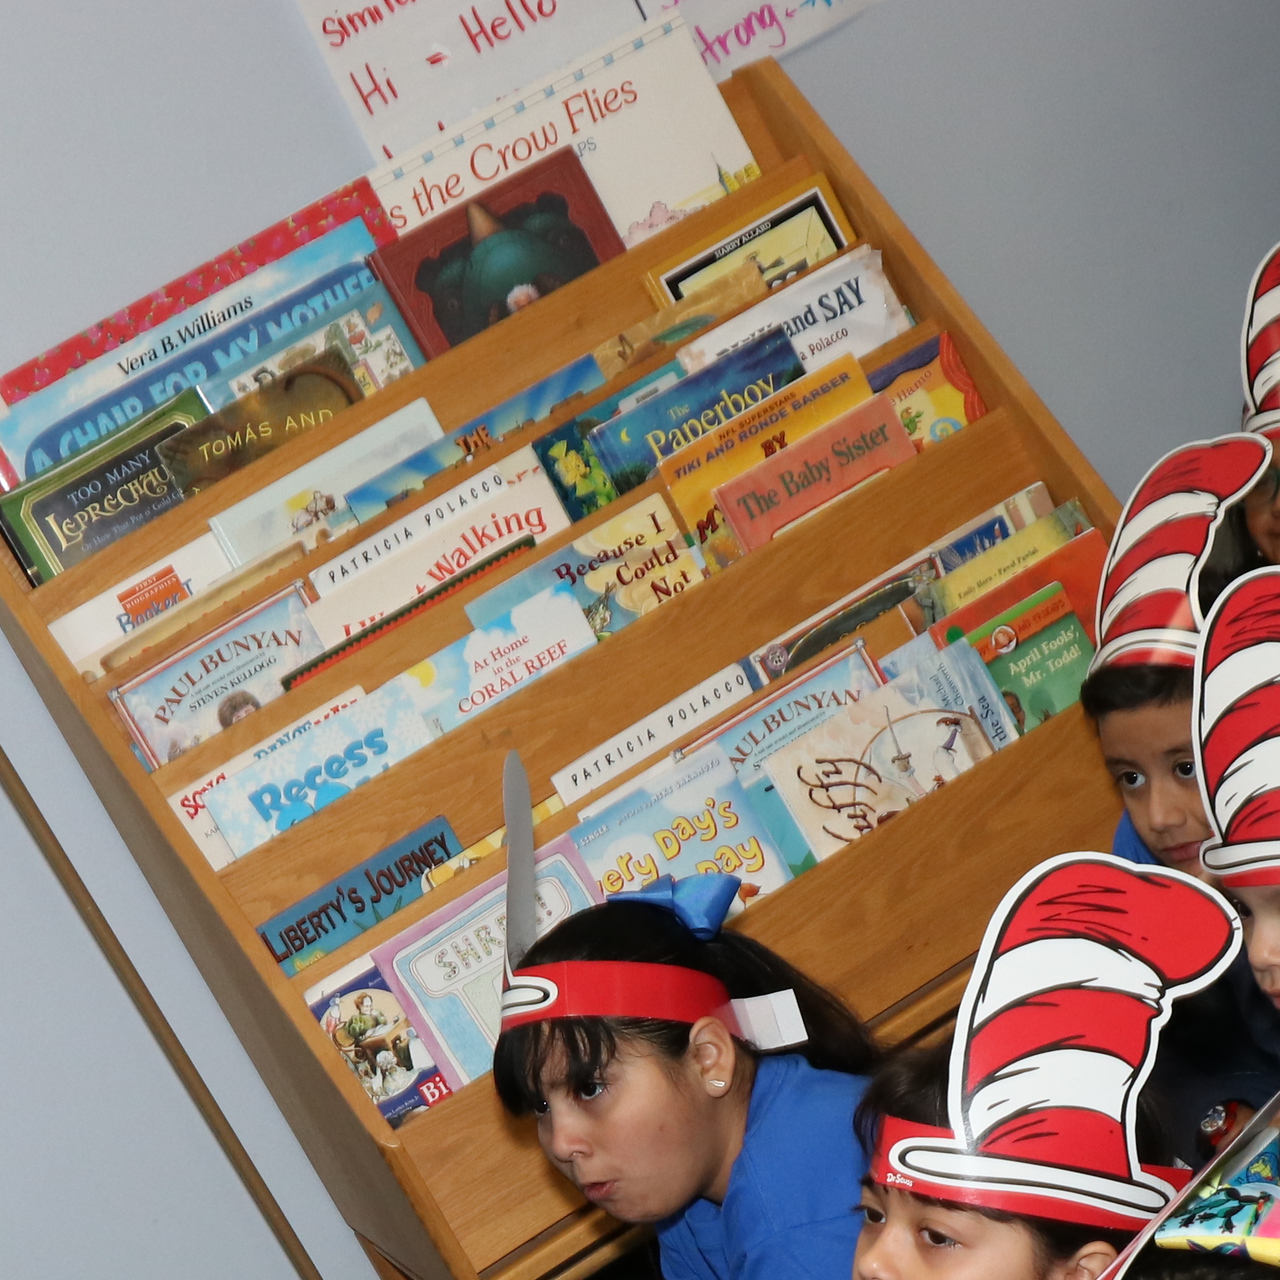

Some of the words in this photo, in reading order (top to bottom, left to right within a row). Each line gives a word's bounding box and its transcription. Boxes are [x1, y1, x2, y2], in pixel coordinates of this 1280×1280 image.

[693, 3, 787, 65] trong
[349, 62, 398, 116] Hi
[390, 205, 408, 229] s
[412, 173, 465, 217] the
[470, 121, 558, 181] Crow
[562, 80, 638, 134] Flies
[577, 137, 598, 158] PS
[715, 236, 741, 259] HARRY
[741, 221, 771, 245] ALLARD
[782, 303, 820, 338] and
[818, 275, 867, 323] SAY
[117, 348, 158, 376] Vera
[160, 335, 179, 354] B.
[177, 296, 254, 344] Williams
[808, 327, 849, 357] Polacco
[199, 420, 273, 462] TOMÁS
[285, 408, 334, 433] AND
[644, 372, 776, 461] Paperboy
[667, 402, 691, 421] The
[674, 458, 702, 480] TIKI
[705, 438, 735, 460] AND
[738, 407, 789, 443] RONDE
[792, 371, 852, 412] BARBER
[718, 426, 738, 440] NFL
[738, 391, 797, 429] SUPERSTARS
[760, 430, 789, 458] BY
[67, 480, 102, 507] TOO
[105, 449, 152, 485] MANY
[736, 487, 781, 522] The
[778, 455, 833, 500] Baby
[830, 422, 891, 468] Sister
[45, 464, 170, 552] LEPRECHAU
[328, 526, 414, 583] PATRICIA
[424, 473, 503, 526] POLACCO
[426, 506, 548, 583] Walking
[553, 532, 647, 587] Because
[647, 511, 666, 536] I
[615, 539, 681, 587] Could
[125, 577, 177, 609] BIOGRAPHIES
[134, 575, 157, 592] FIRST
[649, 568, 692, 604] Not
[116, 592, 181, 634] Booker
[154, 667, 204, 725] PAUL
[199, 628, 304, 675] BUNYAN
[458, 668, 525, 715] CORAL
[523, 639, 570, 677] REEF
[473, 657, 490, 674] At
[489, 634, 530, 664] Home
[491, 665, 502, 677] in
[502, 654, 522, 672] the
[1008, 647, 1042, 677] April
[1021, 670, 1047, 688] Mr.
[1046, 643, 1082, 673] Todd!
[189, 683, 229, 712] STEVEN
[229, 655, 277, 688] KELLOGG
[929, 675, 952, 708] Michael
[935, 662, 966, 706] Chesworth
[976, 694, 996, 720] Sea
[570, 728, 656, 787] PATRICIA
[666, 674, 745, 728] POLACCO
[729, 727, 766, 773] AUL
[762, 689, 862, 734] BUNYAN
[990, 719, 1008, 742] the
[247, 727, 389, 823] Recess
[204, 825, 220, 838] KAR
[581, 824, 609, 846] SINGER
[653, 796, 739, 860] Day's
[261, 884, 367, 963] LIBERTY'S
[363, 831, 452, 905] JOURNEY
